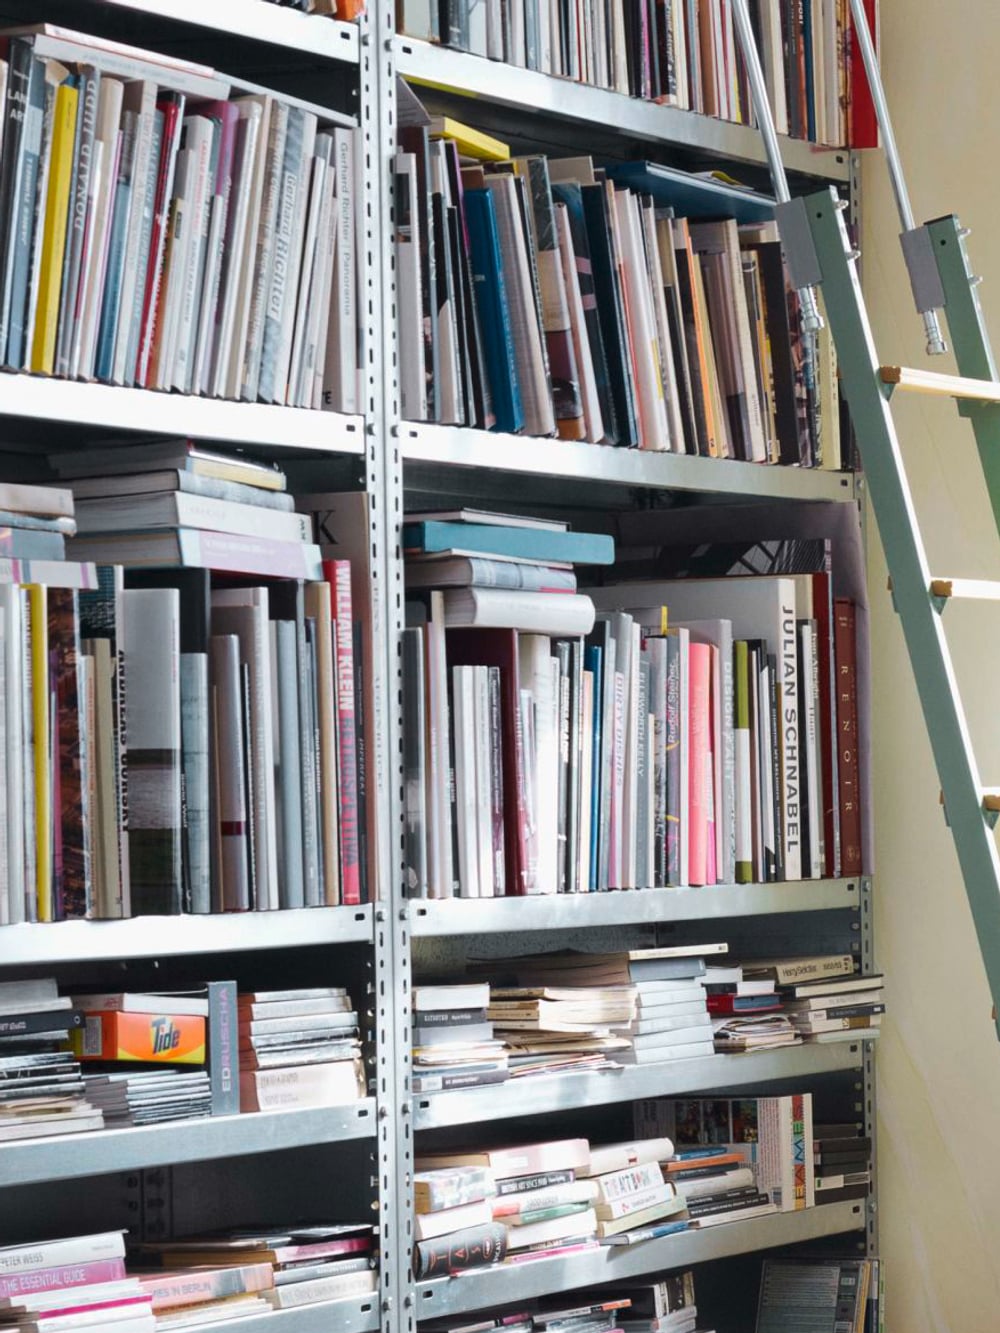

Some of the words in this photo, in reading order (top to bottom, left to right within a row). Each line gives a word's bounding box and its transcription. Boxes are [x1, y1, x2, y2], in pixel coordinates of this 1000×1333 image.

[73, 143, 93, 231] DONALD
[84, 79, 97, 135] JUDD
[143, 129, 160, 203] MALEVICH
[339, 141, 350, 193] Gerhard
[279, 173, 298, 234] Gerhard
[340, 196, 351, 241] Richter
[267, 237, 289, 317] Richter
[341, 251, 354, 316] Panorama
[335, 564, 352, 649] WILLIAM
[337, 653, 353, 710] KLEIN
[668, 661, 678, 703] Steiner
[783, 605, 795, 697] JULIAN
[117, 649, 128, 746] ANDREAS
[615, 676, 625, 723] DIRTY
[637, 671, 645, 741] ELLSWORTH
[667, 705, 676, 743] Rudolf
[723, 661, 734, 727] DESIGN
[636, 742, 644, 777] KELLY
[840, 665, 852, 810] RENOIR
[119, 752, 130, 832] GURSKY
[785, 708, 798, 853] SCHNABEL
[151, 1016, 181, 1056] Tide
[219, 987, 231, 1066] RUSCHA
[221, 1067, 231, 1092] ED
[0, 1277, 19, 1294] THE
[18, 1269, 63, 1293] ESSENTIAL
[61, 1266, 87, 1285] GUIDE
